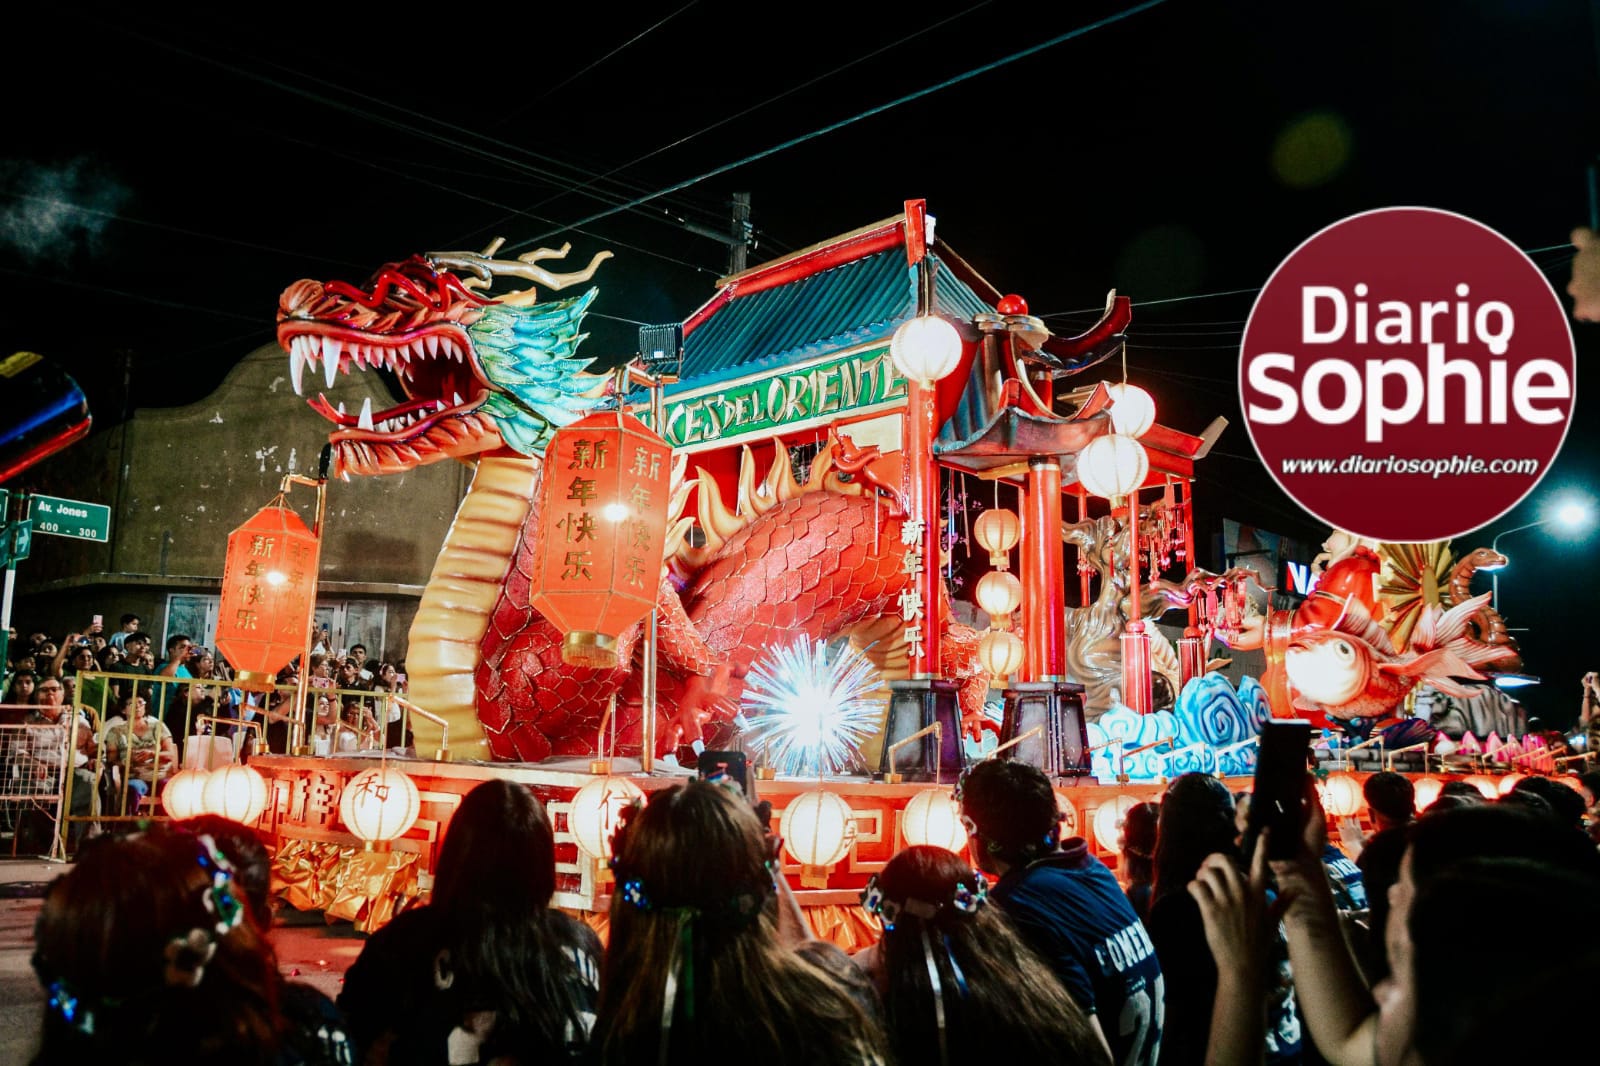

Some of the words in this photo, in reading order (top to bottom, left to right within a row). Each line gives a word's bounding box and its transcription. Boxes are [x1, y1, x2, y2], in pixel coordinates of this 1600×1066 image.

[38, 500, 53, 513] Av.
[57, 503, 89, 519] Jones
[39, 521, 59, 532] 400
[78, 527, 97, 538] 300
[556, 438, 609, 582] 新年快乐
[234, 534, 275, 631] 新年快乐
[897, 519, 926, 658] 新年快乐
[355, 771, 393, 809] 和
